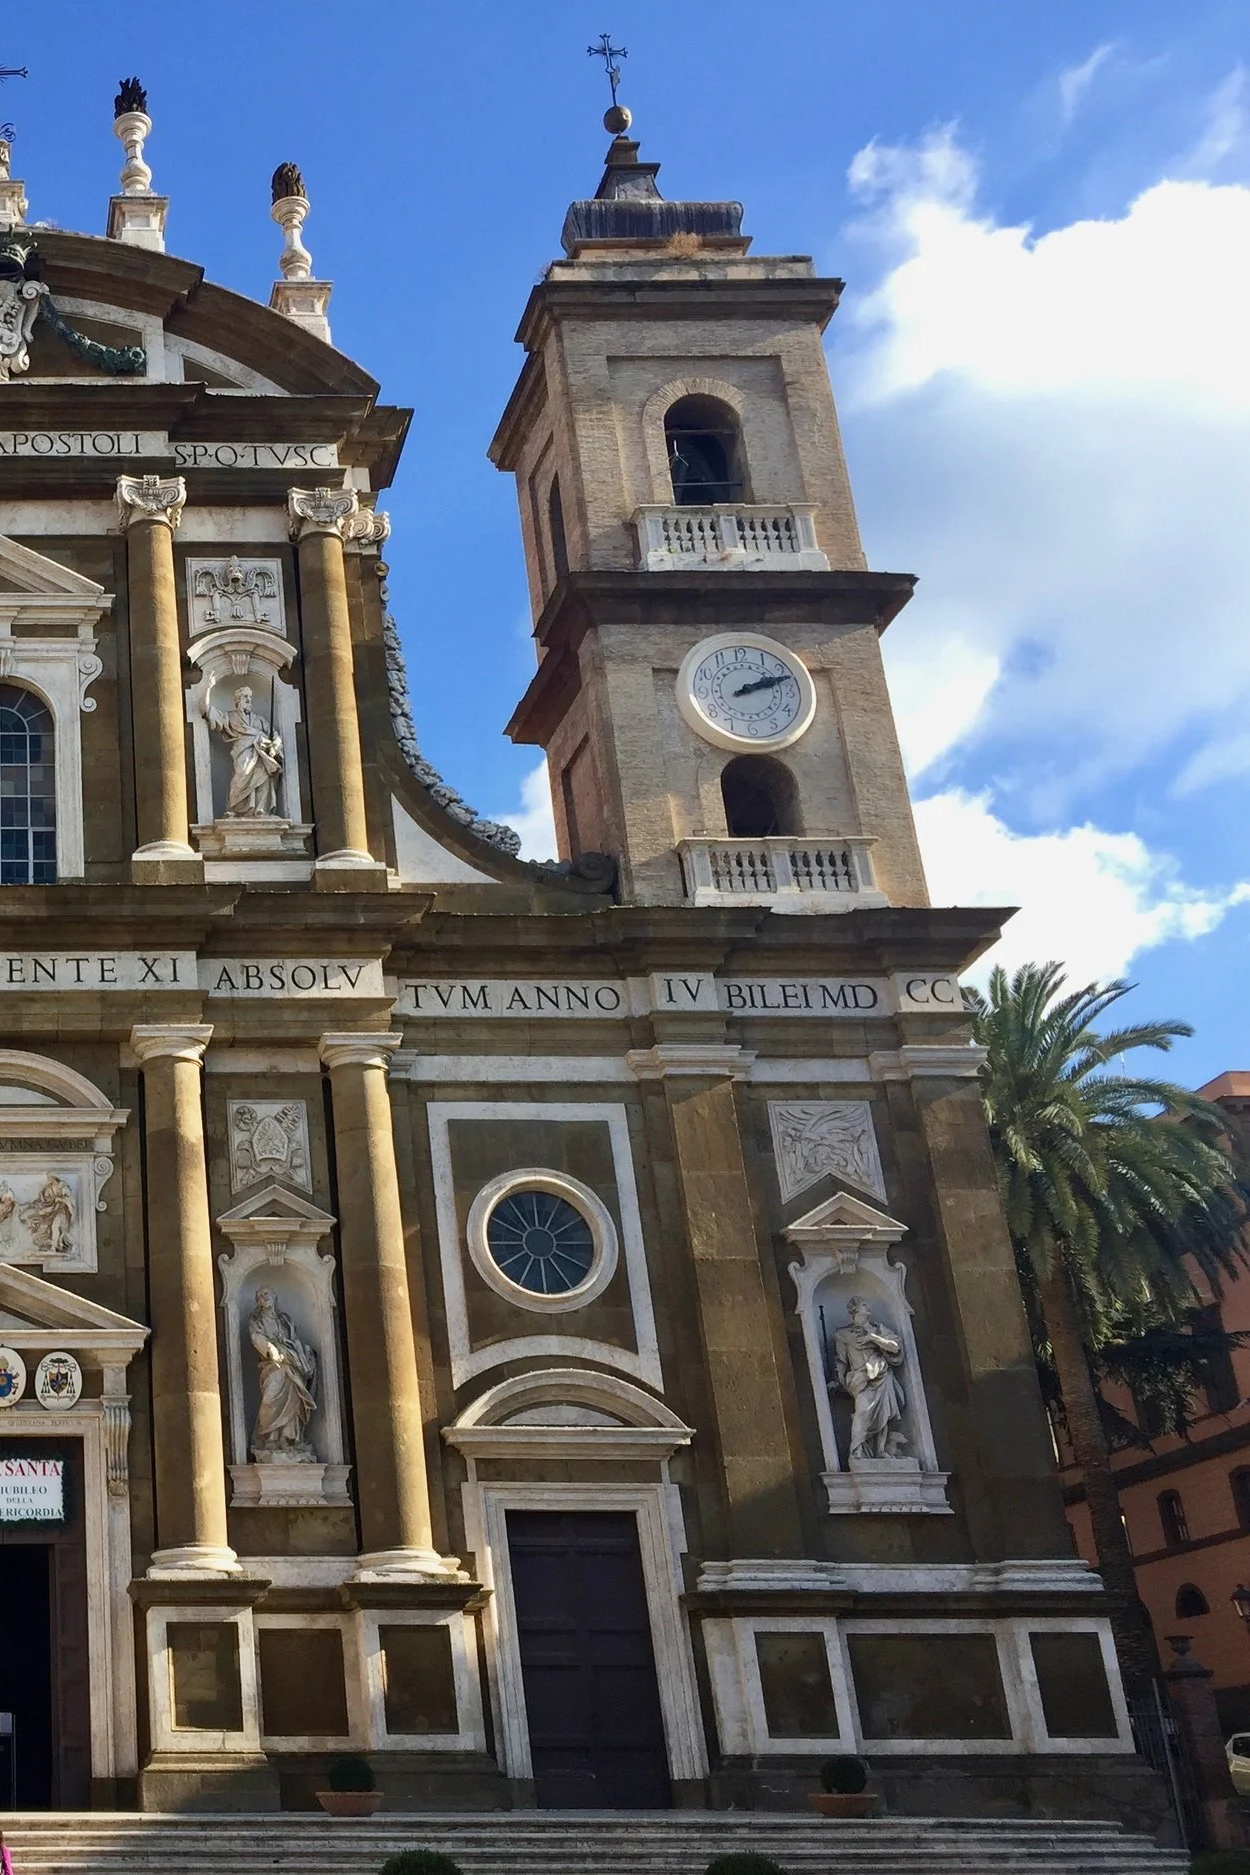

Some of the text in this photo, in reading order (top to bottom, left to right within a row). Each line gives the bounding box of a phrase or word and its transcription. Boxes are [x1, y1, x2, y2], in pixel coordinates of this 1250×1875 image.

[715, 651, 725, 668] 11
[733, 647, 748, 662] 12
[699, 667, 712, 682] 10
[697, 686, 709, 700] 9
[785, 684, 796, 699] 3
[707, 703, 719, 719] 8
[782, 703, 792, 718] 4
[724, 717, 734, 731] 7
[747, 721, 759, 737] 6
[769, 717, 779, 730] 5
[137, 957, 181, 983] XI
[213, 964, 365, 991] ABSOLV
[404, 984, 492, 1010] TVM
[505, 985, 621, 1011] ANNO
[663, 978, 705, 1004] IV
[905, 978, 955, 1004] CC
[4, 1461, 61, 1477] SANTA
